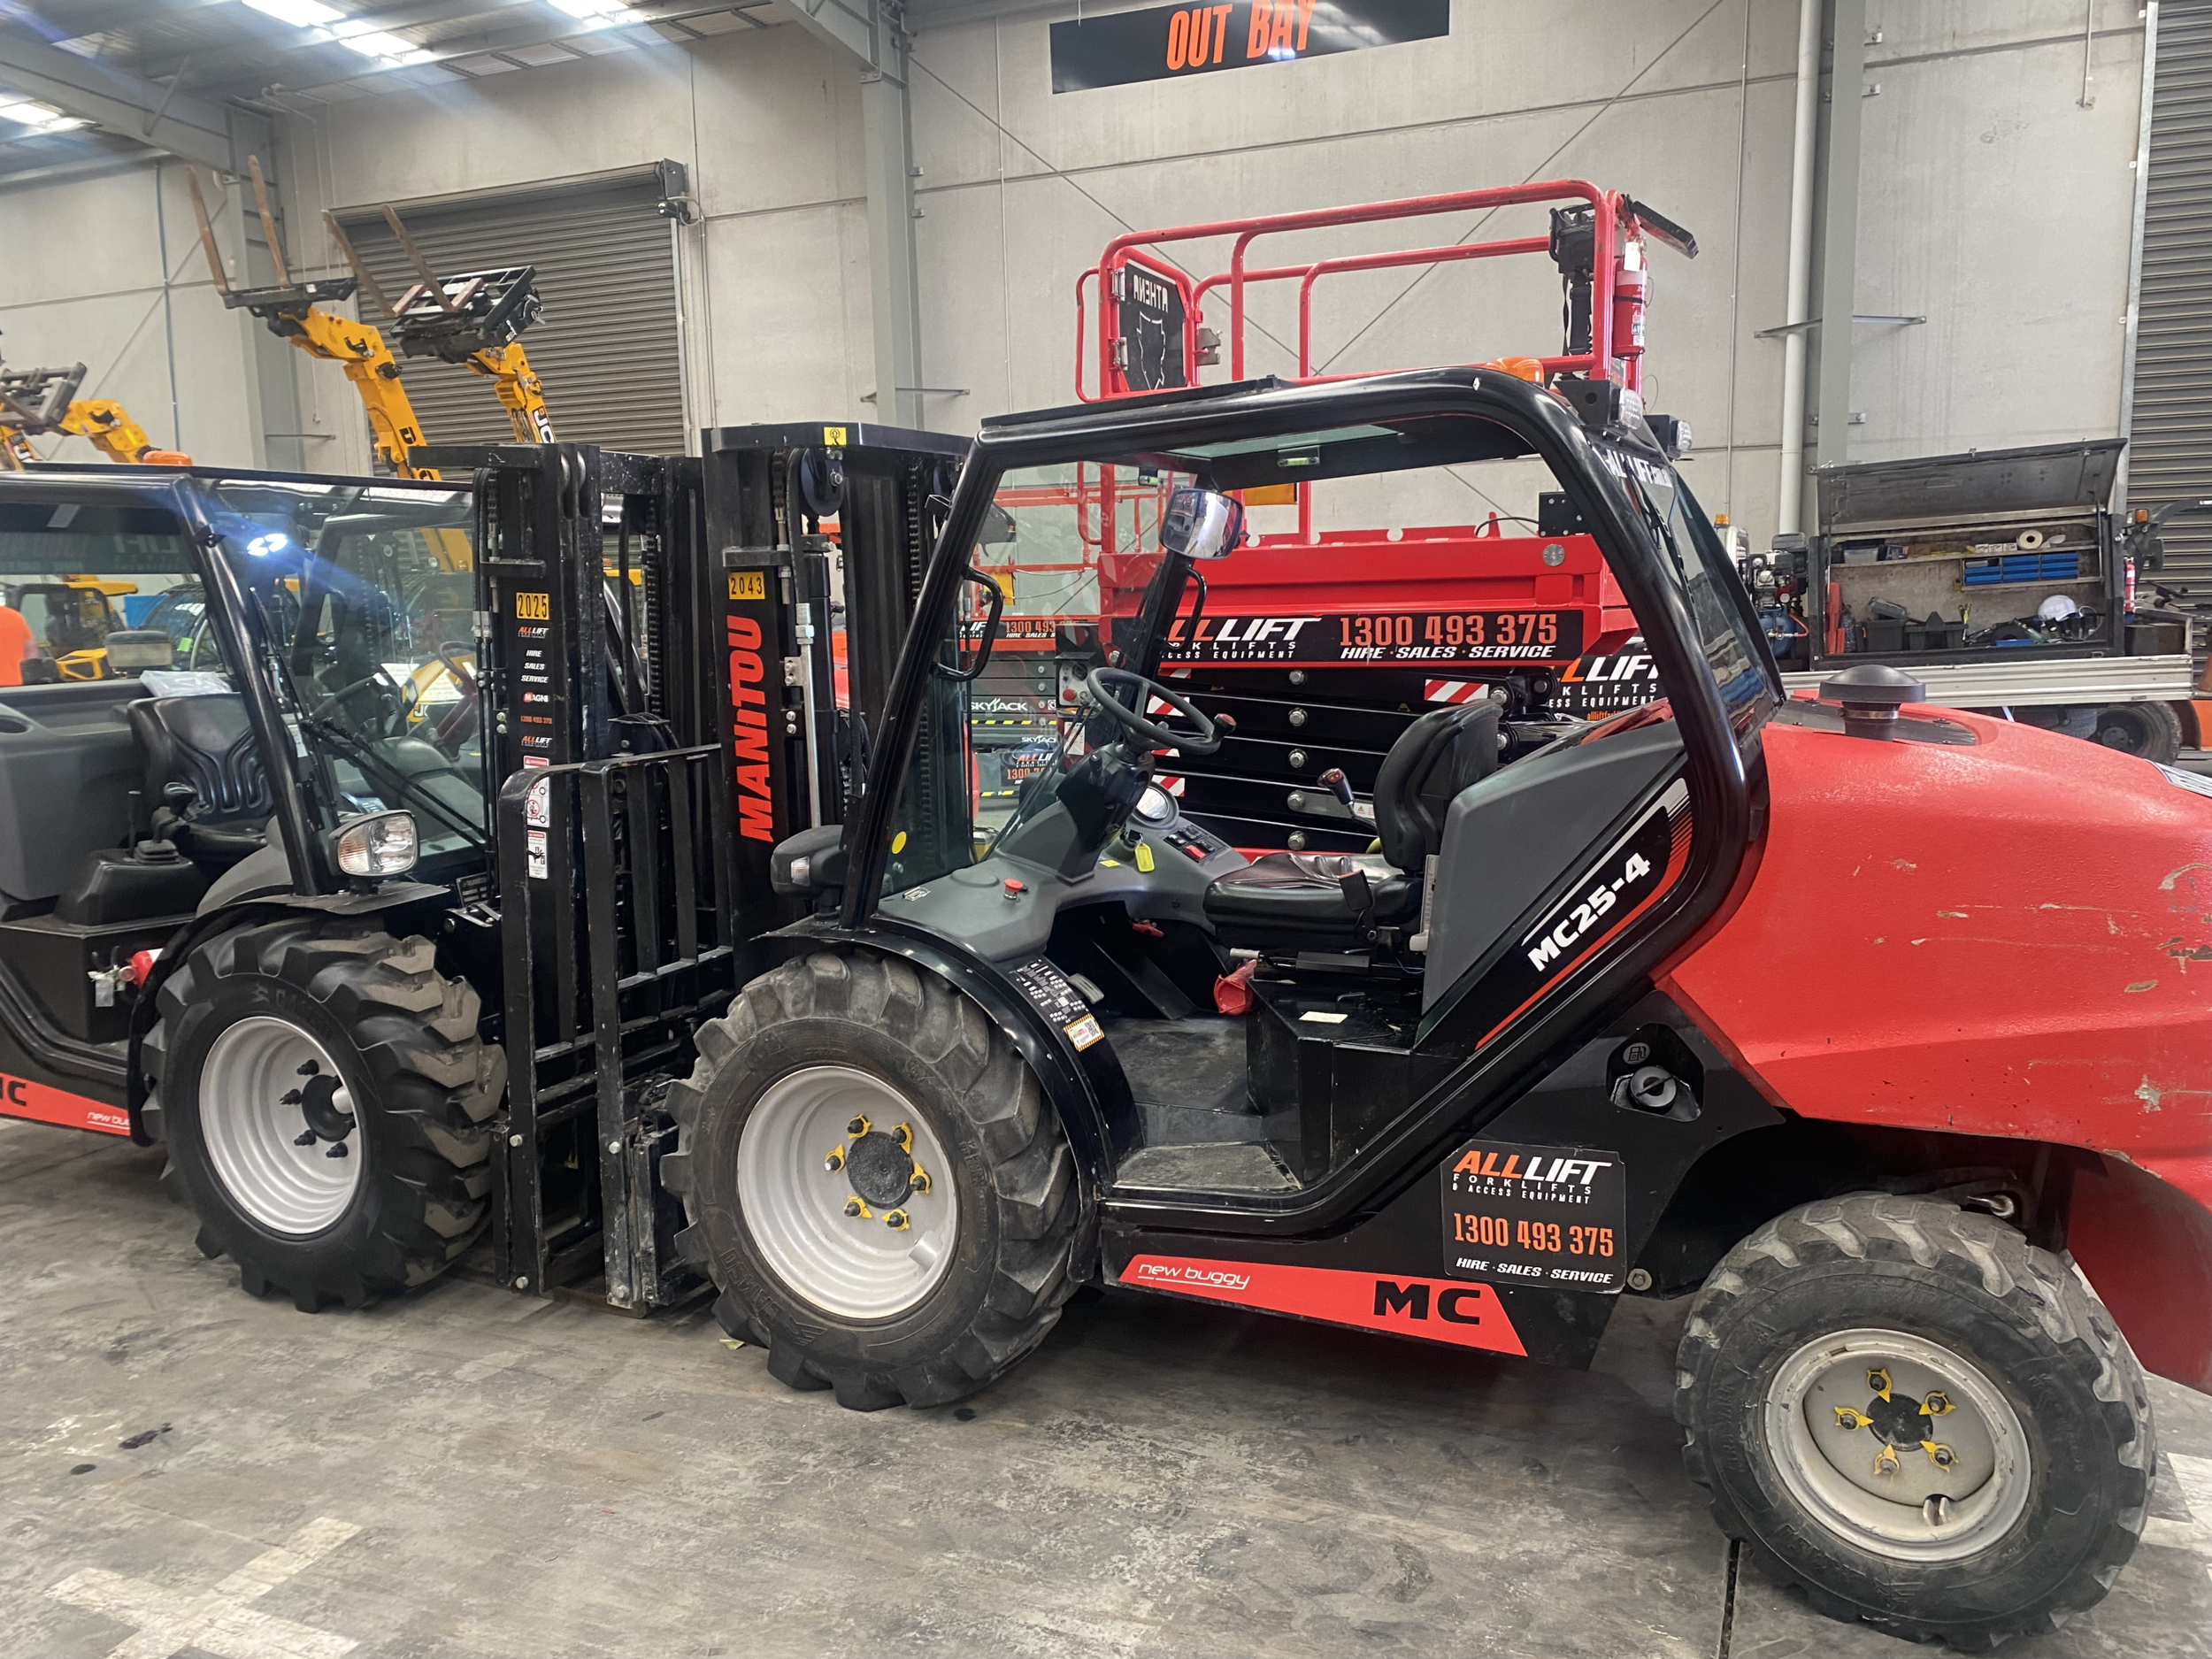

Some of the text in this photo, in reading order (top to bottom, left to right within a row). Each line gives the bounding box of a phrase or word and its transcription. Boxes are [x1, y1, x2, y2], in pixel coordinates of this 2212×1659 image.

[1166, 0, 1315, 70] OUT BAY
[731, 576, 763, 595] 2043
[518, 594, 548, 618] 2025
[1006, 621, 1032, 633] 1300
[1035, 621, 1056, 633] 493
[1167, 618, 1322, 641] LLLIFT
[1340, 614, 1557, 646] 1300 493 375
[1213, 650, 1294, 659] EQUIPMENT
[1340, 645, 1556, 659] HIRE SALES SERVICE
[524, 662, 545, 671] SALES
[520, 674, 549, 684] SERVICE
[971, 697, 1028, 712] SKYJACK
[1582, 695, 1655, 708] EQUIPMENT
[726, 615, 774, 843] MANITOU
[1527, 852, 1651, 972] MC25-4
[0, 1077, 27, 1107] C
[1454, 1173, 1592, 1194] FORKLIFTS
[1468, 1184, 1511, 1197] ACCESS
[1522, 1191, 1590, 1204] EQUIPMENT
[1454, 1212, 1614, 1257] 1300 493 375
[1138, 1263, 1250, 1289] new buggy
[1455, 1257, 1614, 1284] HIRE SALES SERVICE
[1373, 1280, 1481, 1325] MC
